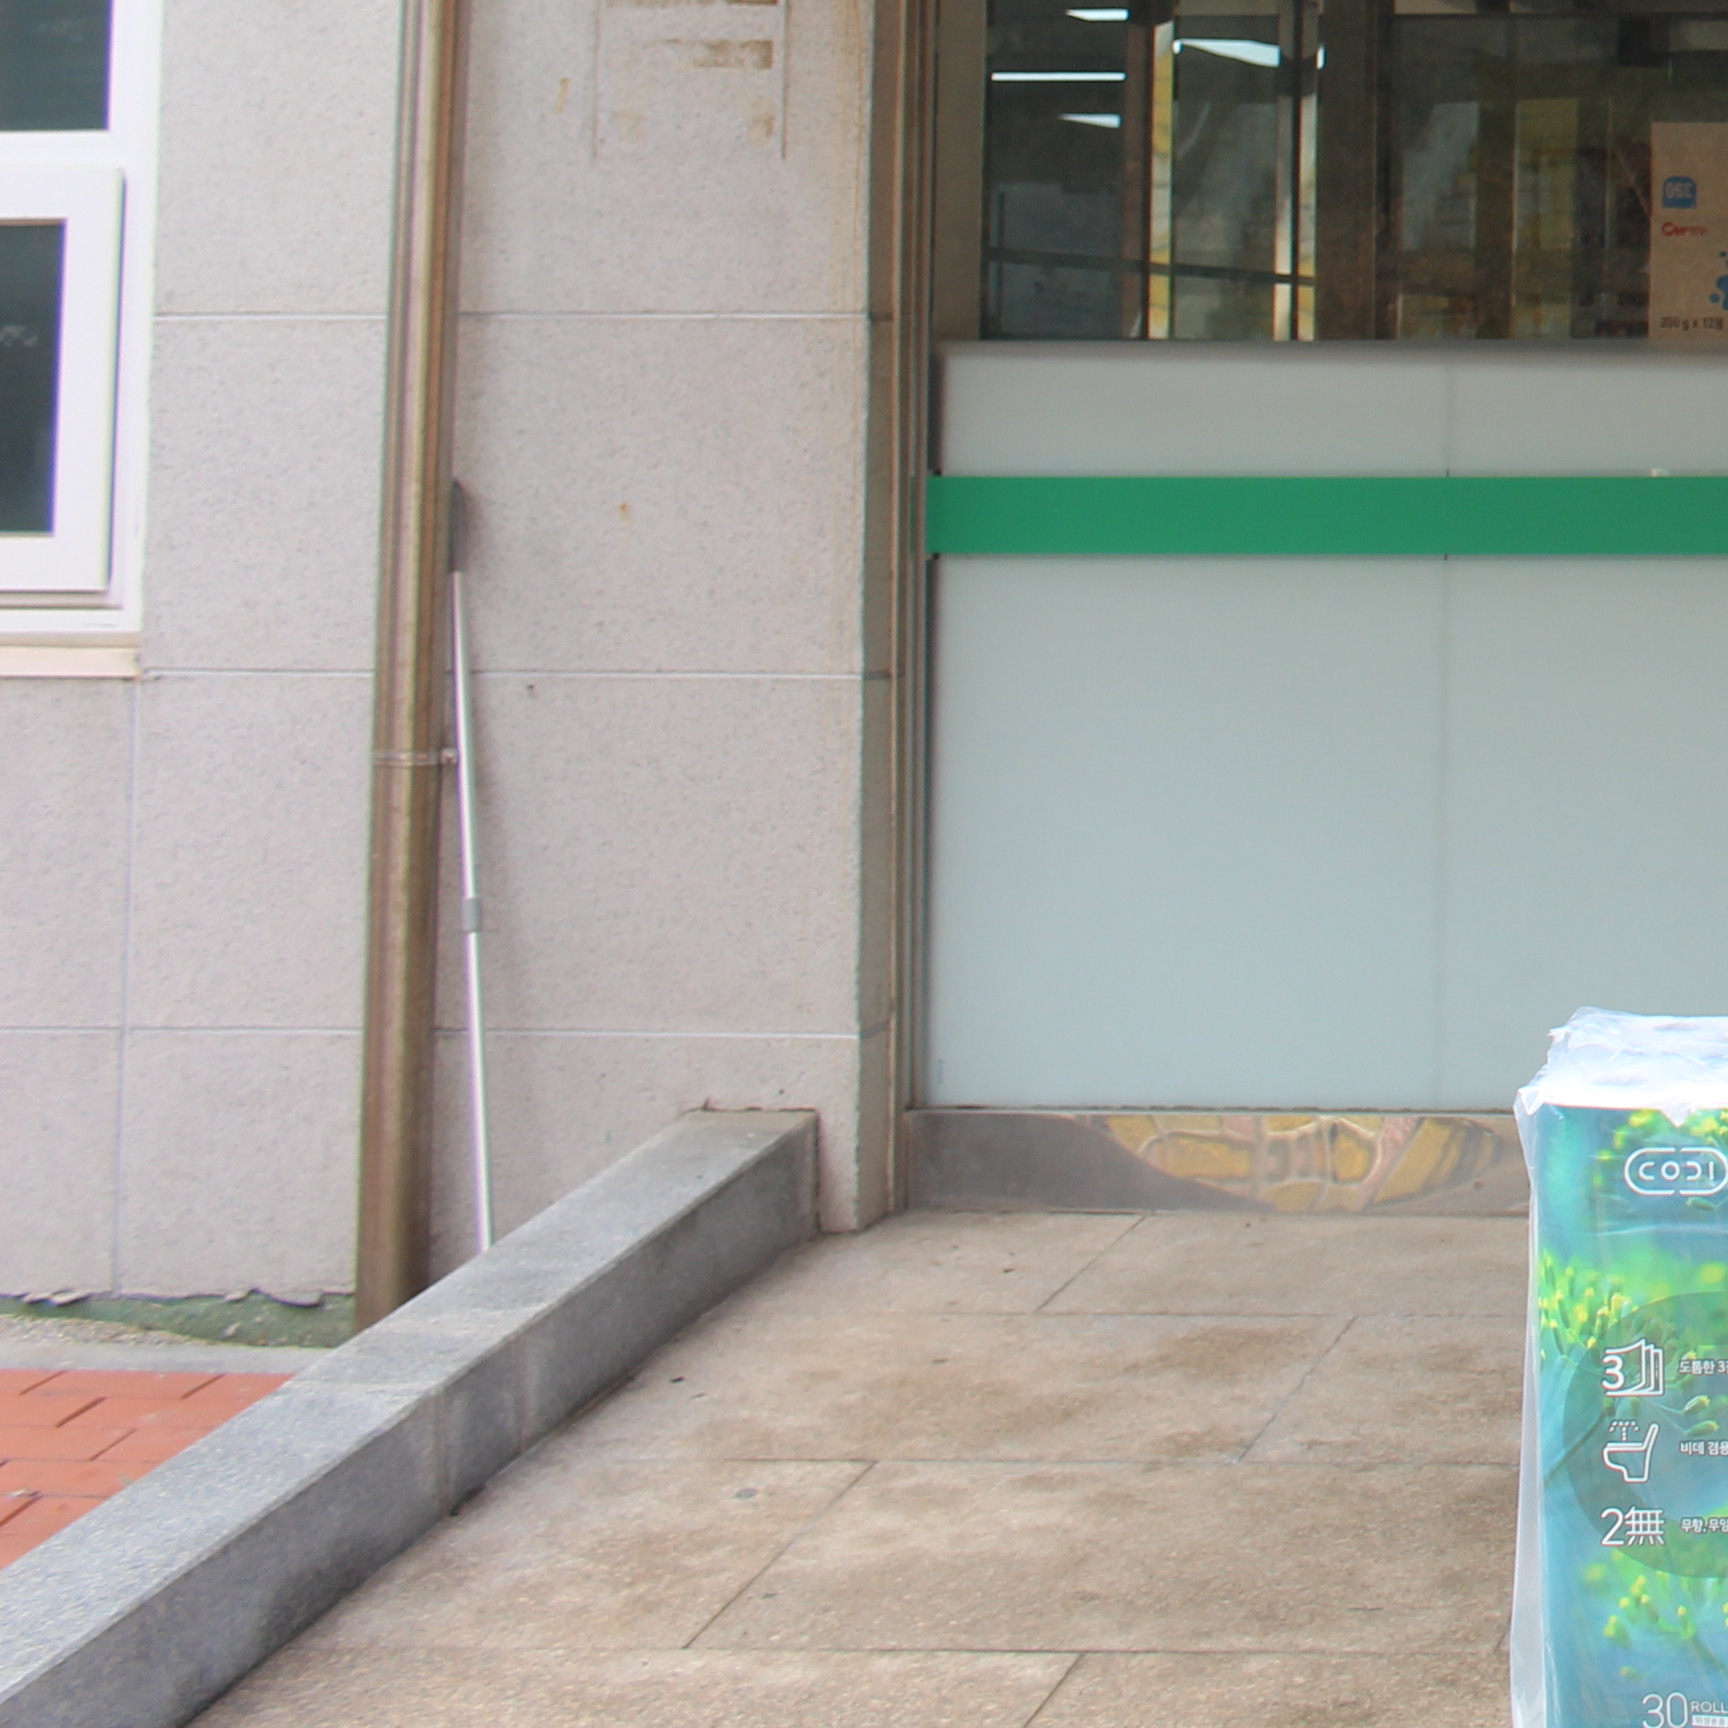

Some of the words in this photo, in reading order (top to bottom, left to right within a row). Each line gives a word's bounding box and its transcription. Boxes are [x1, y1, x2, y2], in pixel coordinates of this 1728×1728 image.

[1679, 1359, 1715, 1374] 도톰한
[1680, 1441, 1705, 1456] 비데
[1642, 1691, 1689, 1728] 30
[1690, 1701, 1728, 1714] ROLL
